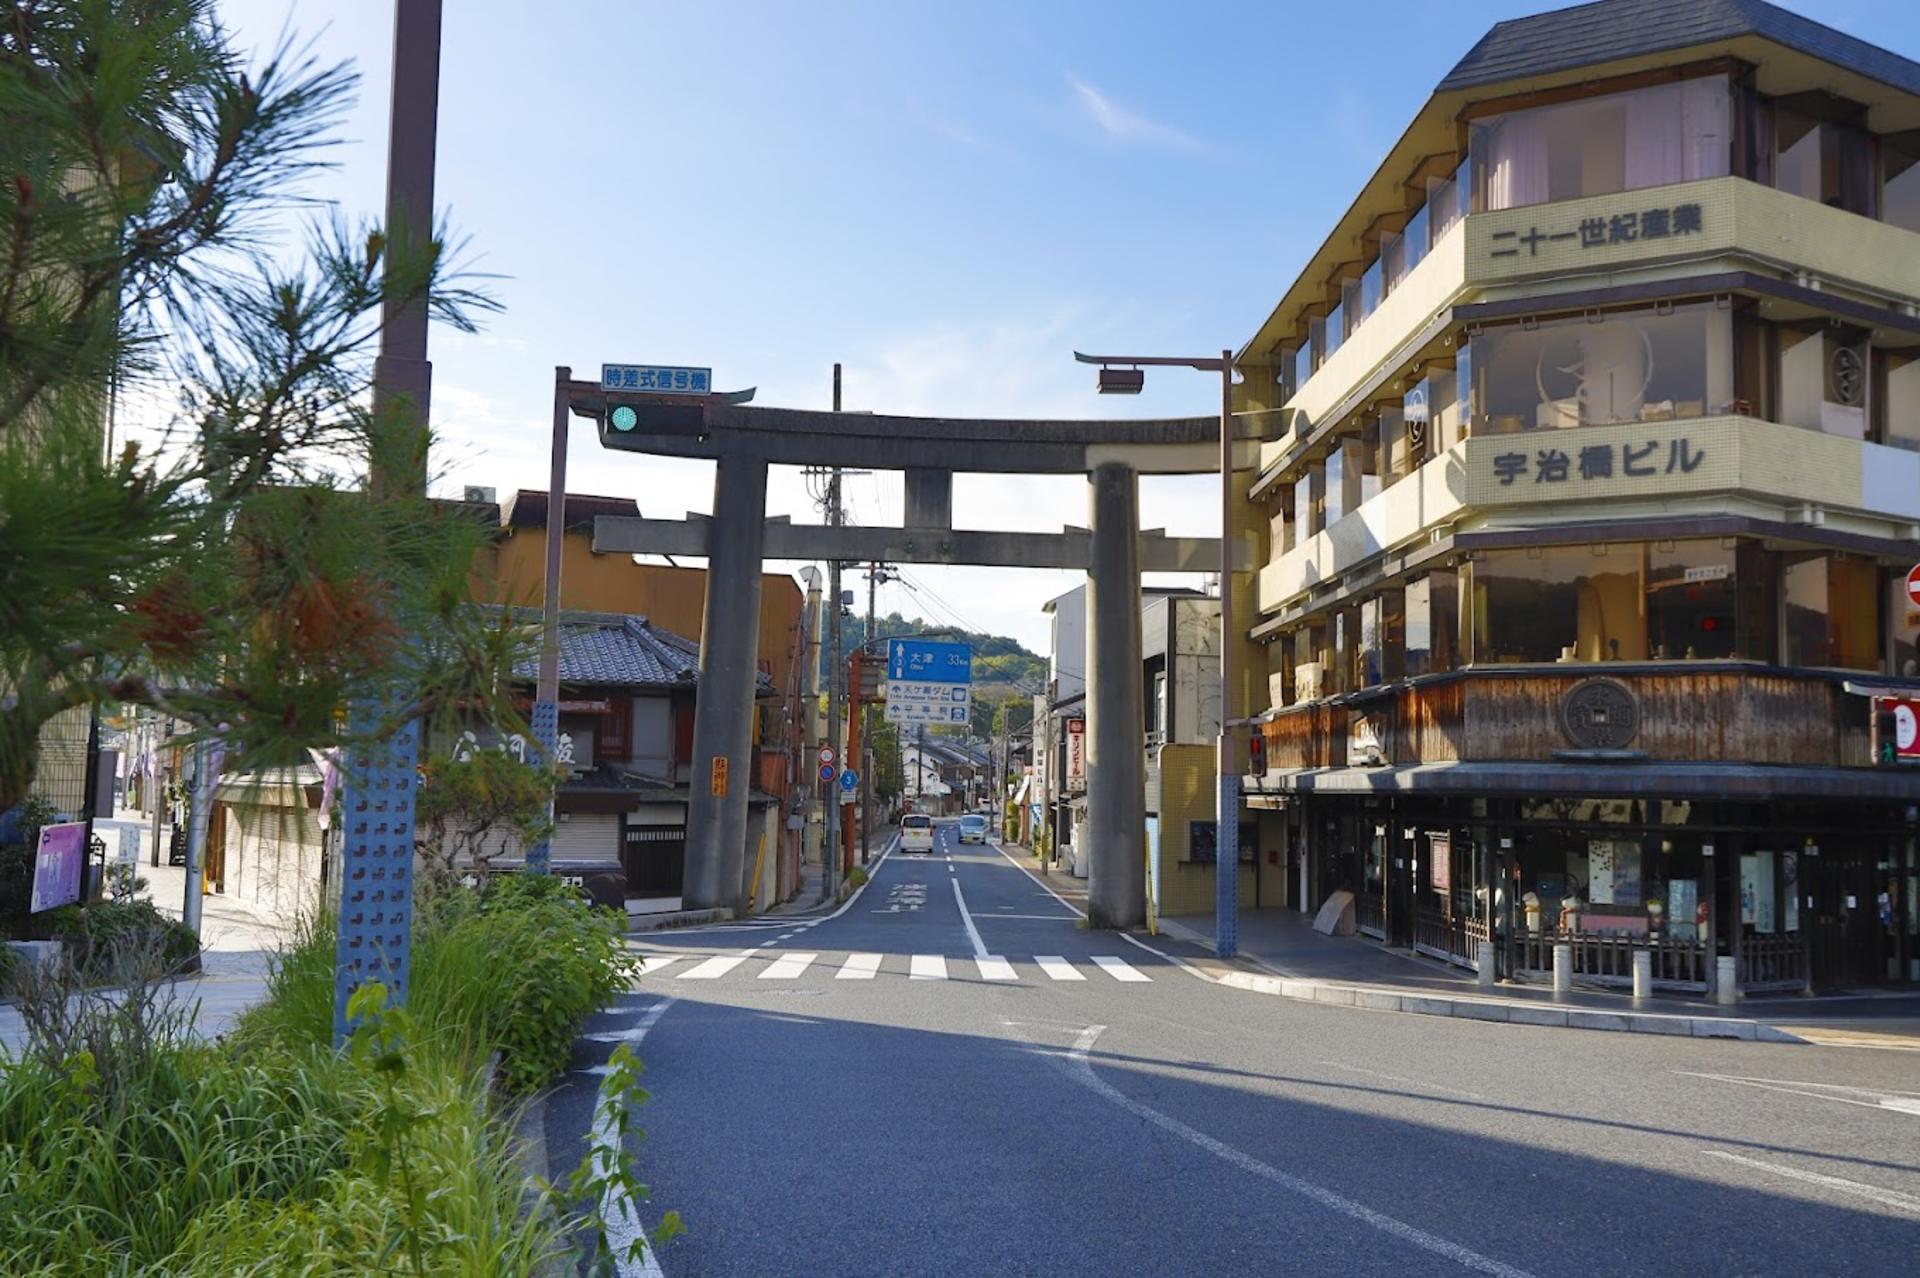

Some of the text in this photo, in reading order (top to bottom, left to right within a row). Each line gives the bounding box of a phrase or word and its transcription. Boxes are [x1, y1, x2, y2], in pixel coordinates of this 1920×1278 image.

[1491, 204, 1702, 256] 二十一世紀産業
[606, 368, 706, 390] 時差式信号機
[1493, 437, 1705, 486] 宇治橋ビル
[910, 653, 934, 664] 大津
[1072, 735, 1081, 775] キリンビール
[846, 776, 852, 784] 3
